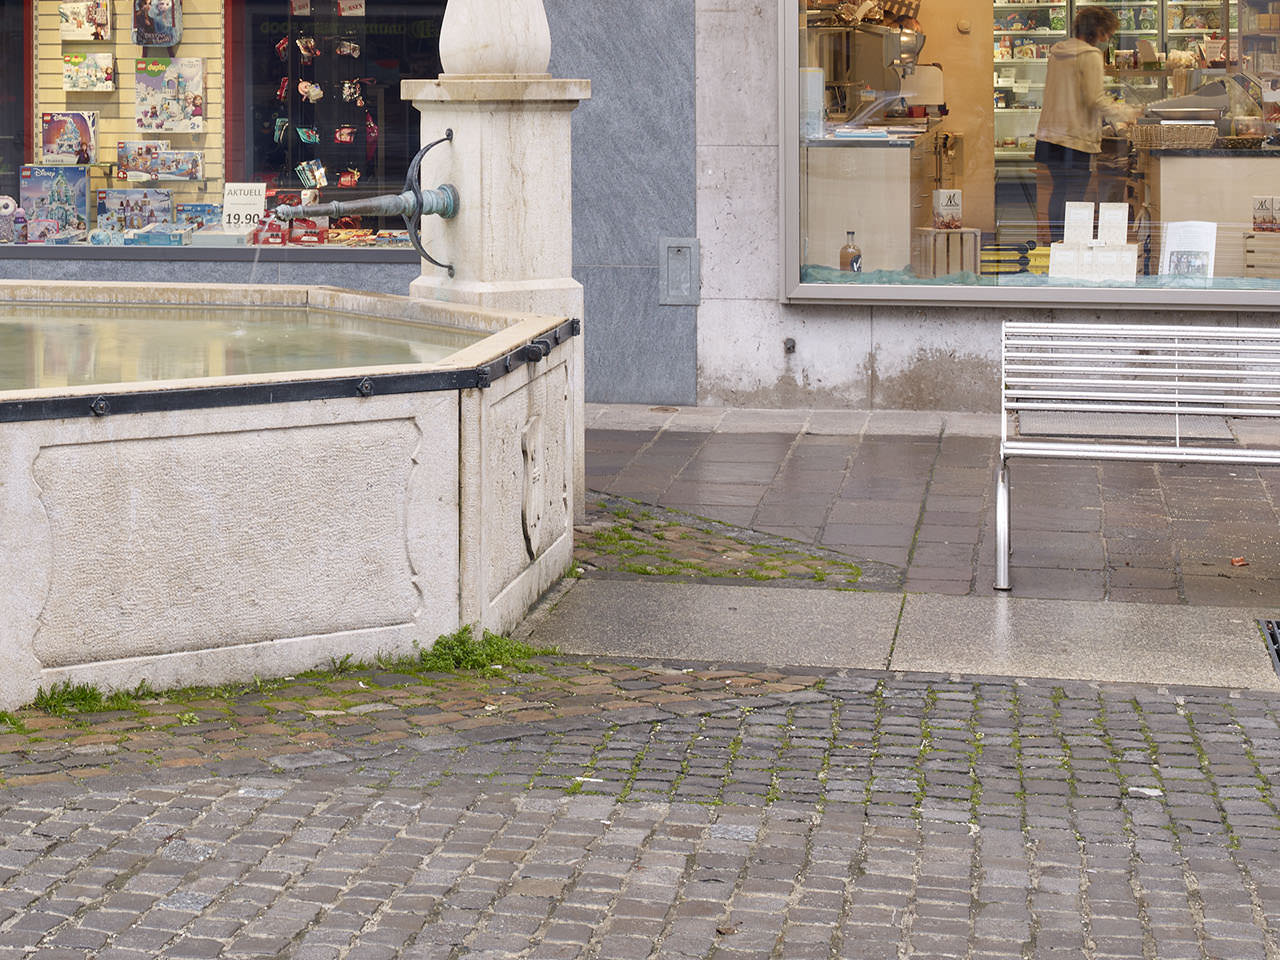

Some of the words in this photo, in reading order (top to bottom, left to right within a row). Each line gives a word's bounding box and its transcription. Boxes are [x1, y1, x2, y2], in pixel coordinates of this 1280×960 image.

[33, 168, 56, 178] Disney
[227, 189, 262, 197] AKTUELL
[226, 213, 260, 225] 19.90
